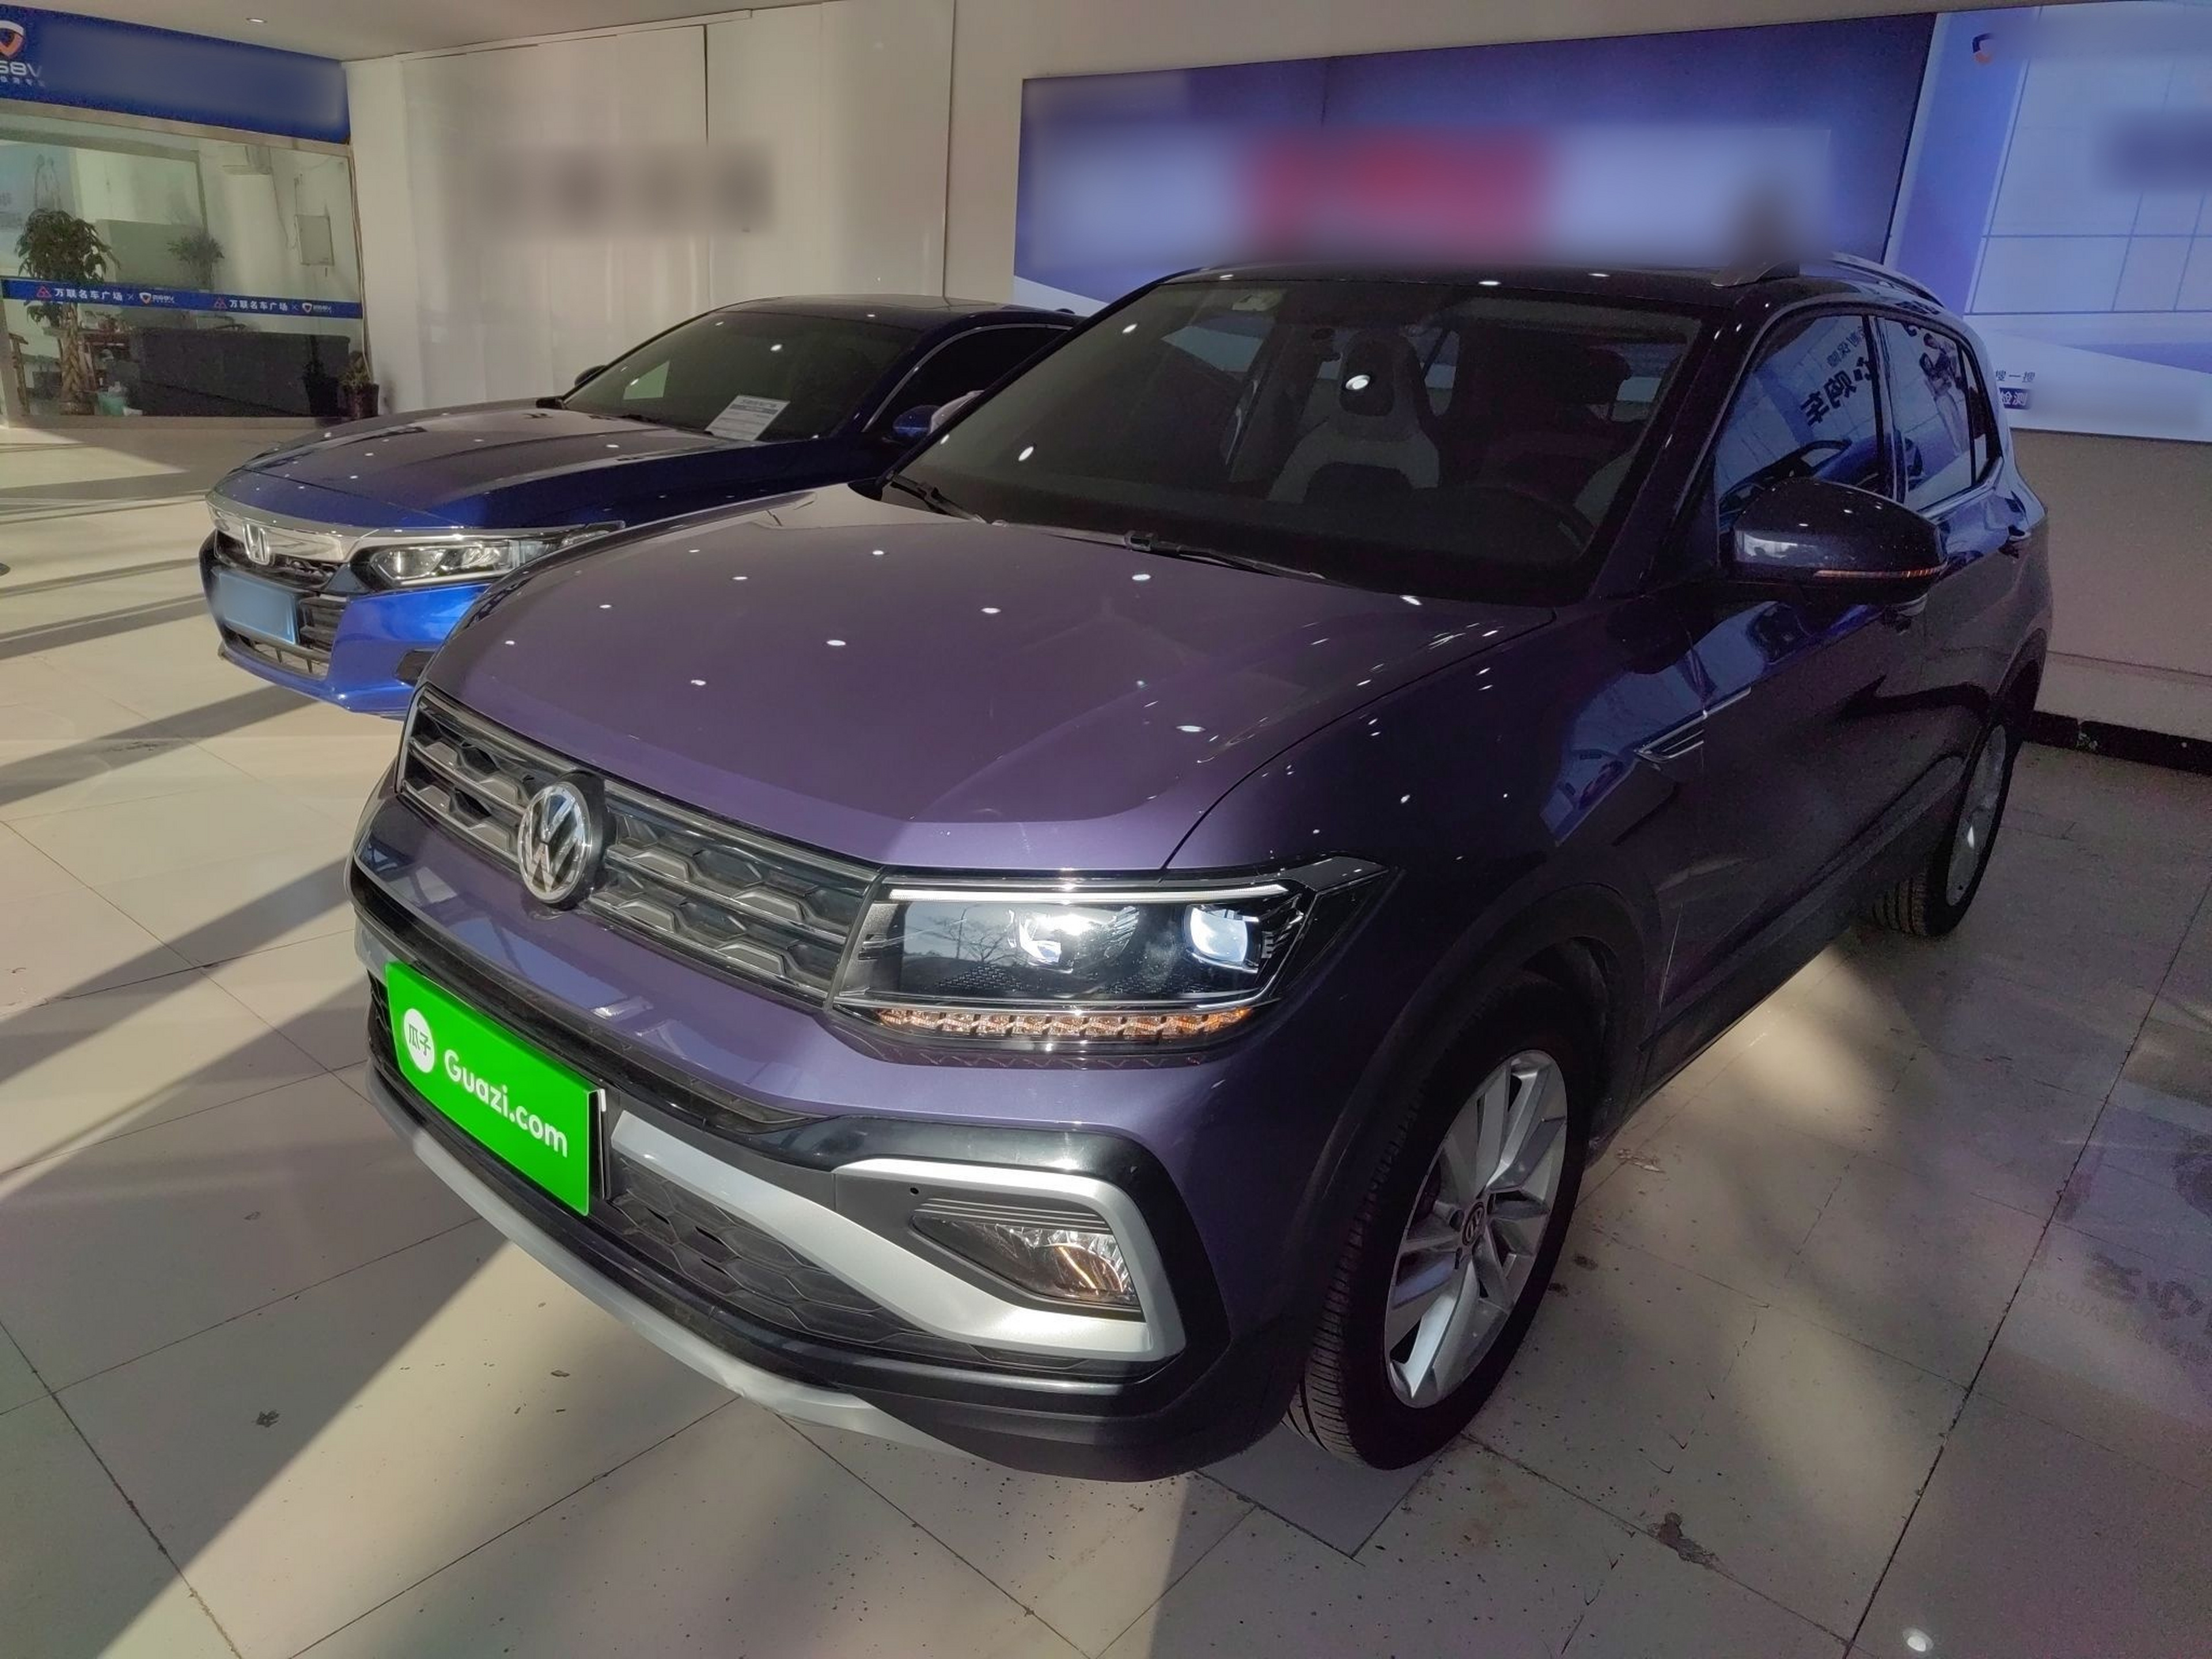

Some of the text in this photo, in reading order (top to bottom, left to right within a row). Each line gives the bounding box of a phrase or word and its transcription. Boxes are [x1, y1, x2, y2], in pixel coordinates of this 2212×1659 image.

[55, 288, 123, 301] 万联名车广场
[229, 300, 288, 311] 万联名车广场
